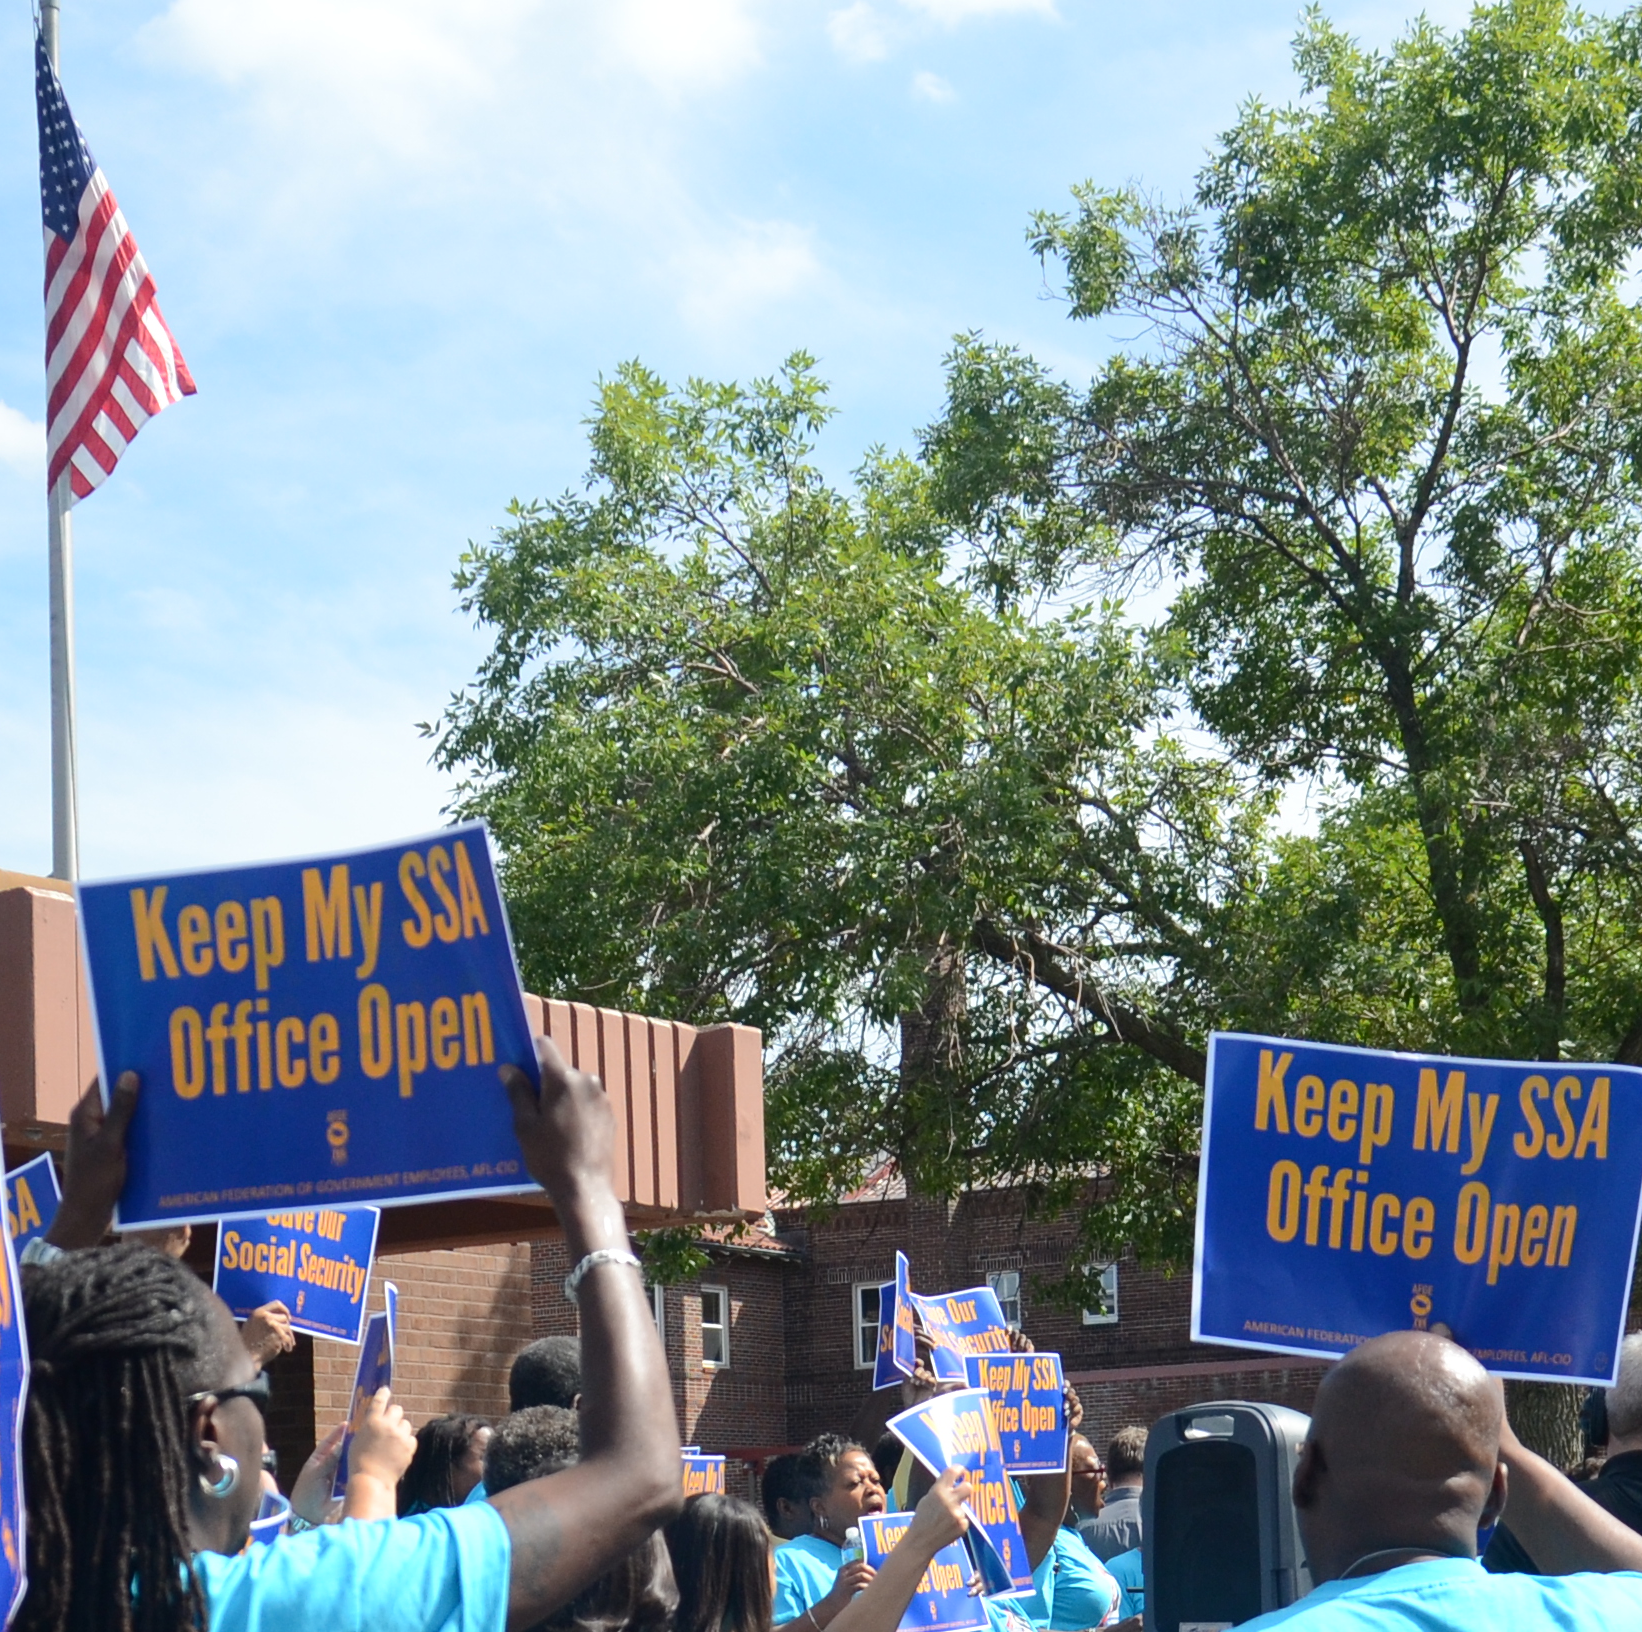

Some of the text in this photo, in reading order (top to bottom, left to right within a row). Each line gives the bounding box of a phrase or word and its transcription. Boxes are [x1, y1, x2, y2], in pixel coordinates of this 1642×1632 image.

[129, 840, 490, 991] Keep My SSA
[168, 983, 495, 1100] Office Open
[1253, 1049, 1612, 1177] Keep My SSA
[158, 1189, 219, 1208] AMERICAN
[221, 1182, 296, 1204] FEDERATION
[295, 1181, 315, 1196] OF
[316, 1173, 400, 1195] GOVERNMENT
[471, 1159, 519, 1179] AFL-CIO
[1265, 1158, 1579, 1286] Office Open
[222, 1230, 367, 1305] Social Security
[946, 1297, 978, 1325] Our
[1243, 1319, 1306, 1339] AMERICAN
[1306, 1327, 1375, 1346] FEDERATIO
[1530, 1351, 1573, 1366] AFL-CIO
[978, 1357, 1059, 1399] Keep My SSA
[1020, 1399, 1056, 1440] Open
[872, 1520, 911, 1555] Kee
[928, 1558, 964, 1599] Open
